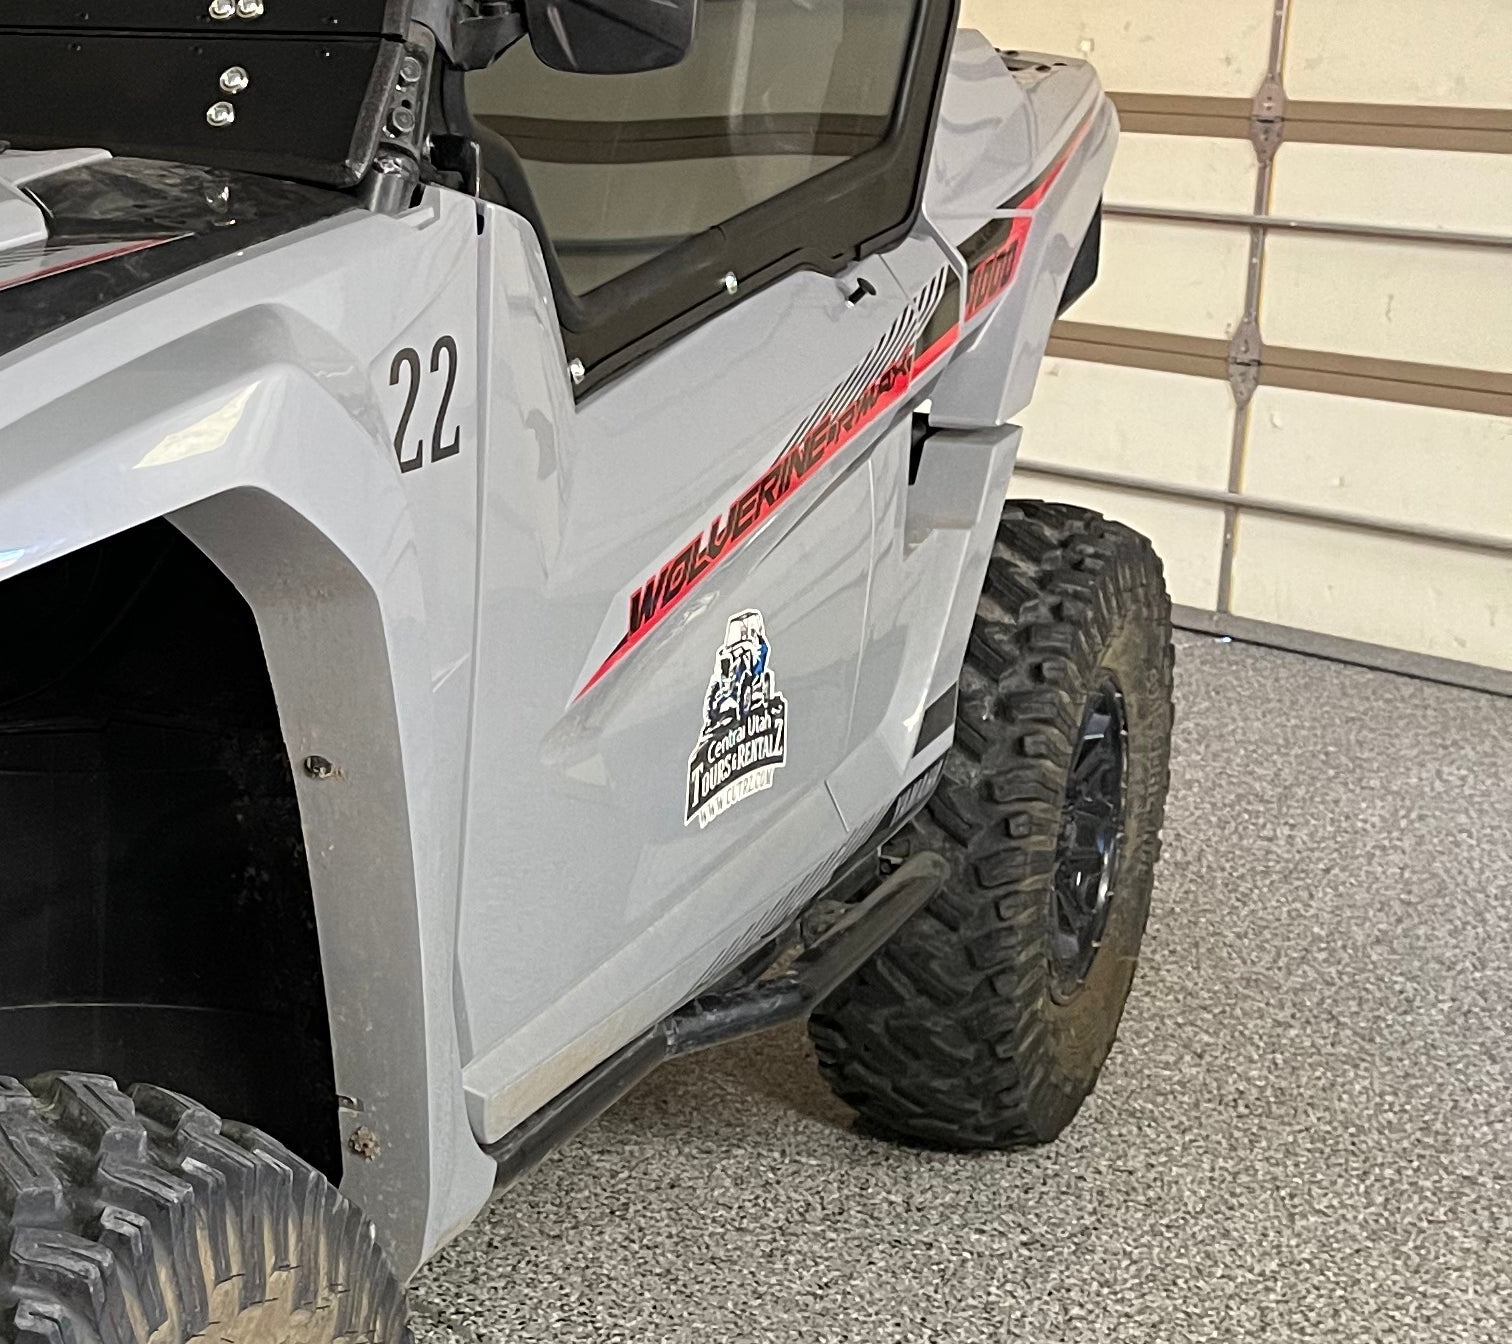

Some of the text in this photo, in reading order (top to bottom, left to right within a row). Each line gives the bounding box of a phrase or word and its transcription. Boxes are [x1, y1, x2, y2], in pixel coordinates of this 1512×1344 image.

[389, 335, 460, 474] 22
[629, 410, 832, 638] WOLVERINE
[707, 709, 772, 764] Central Utah
